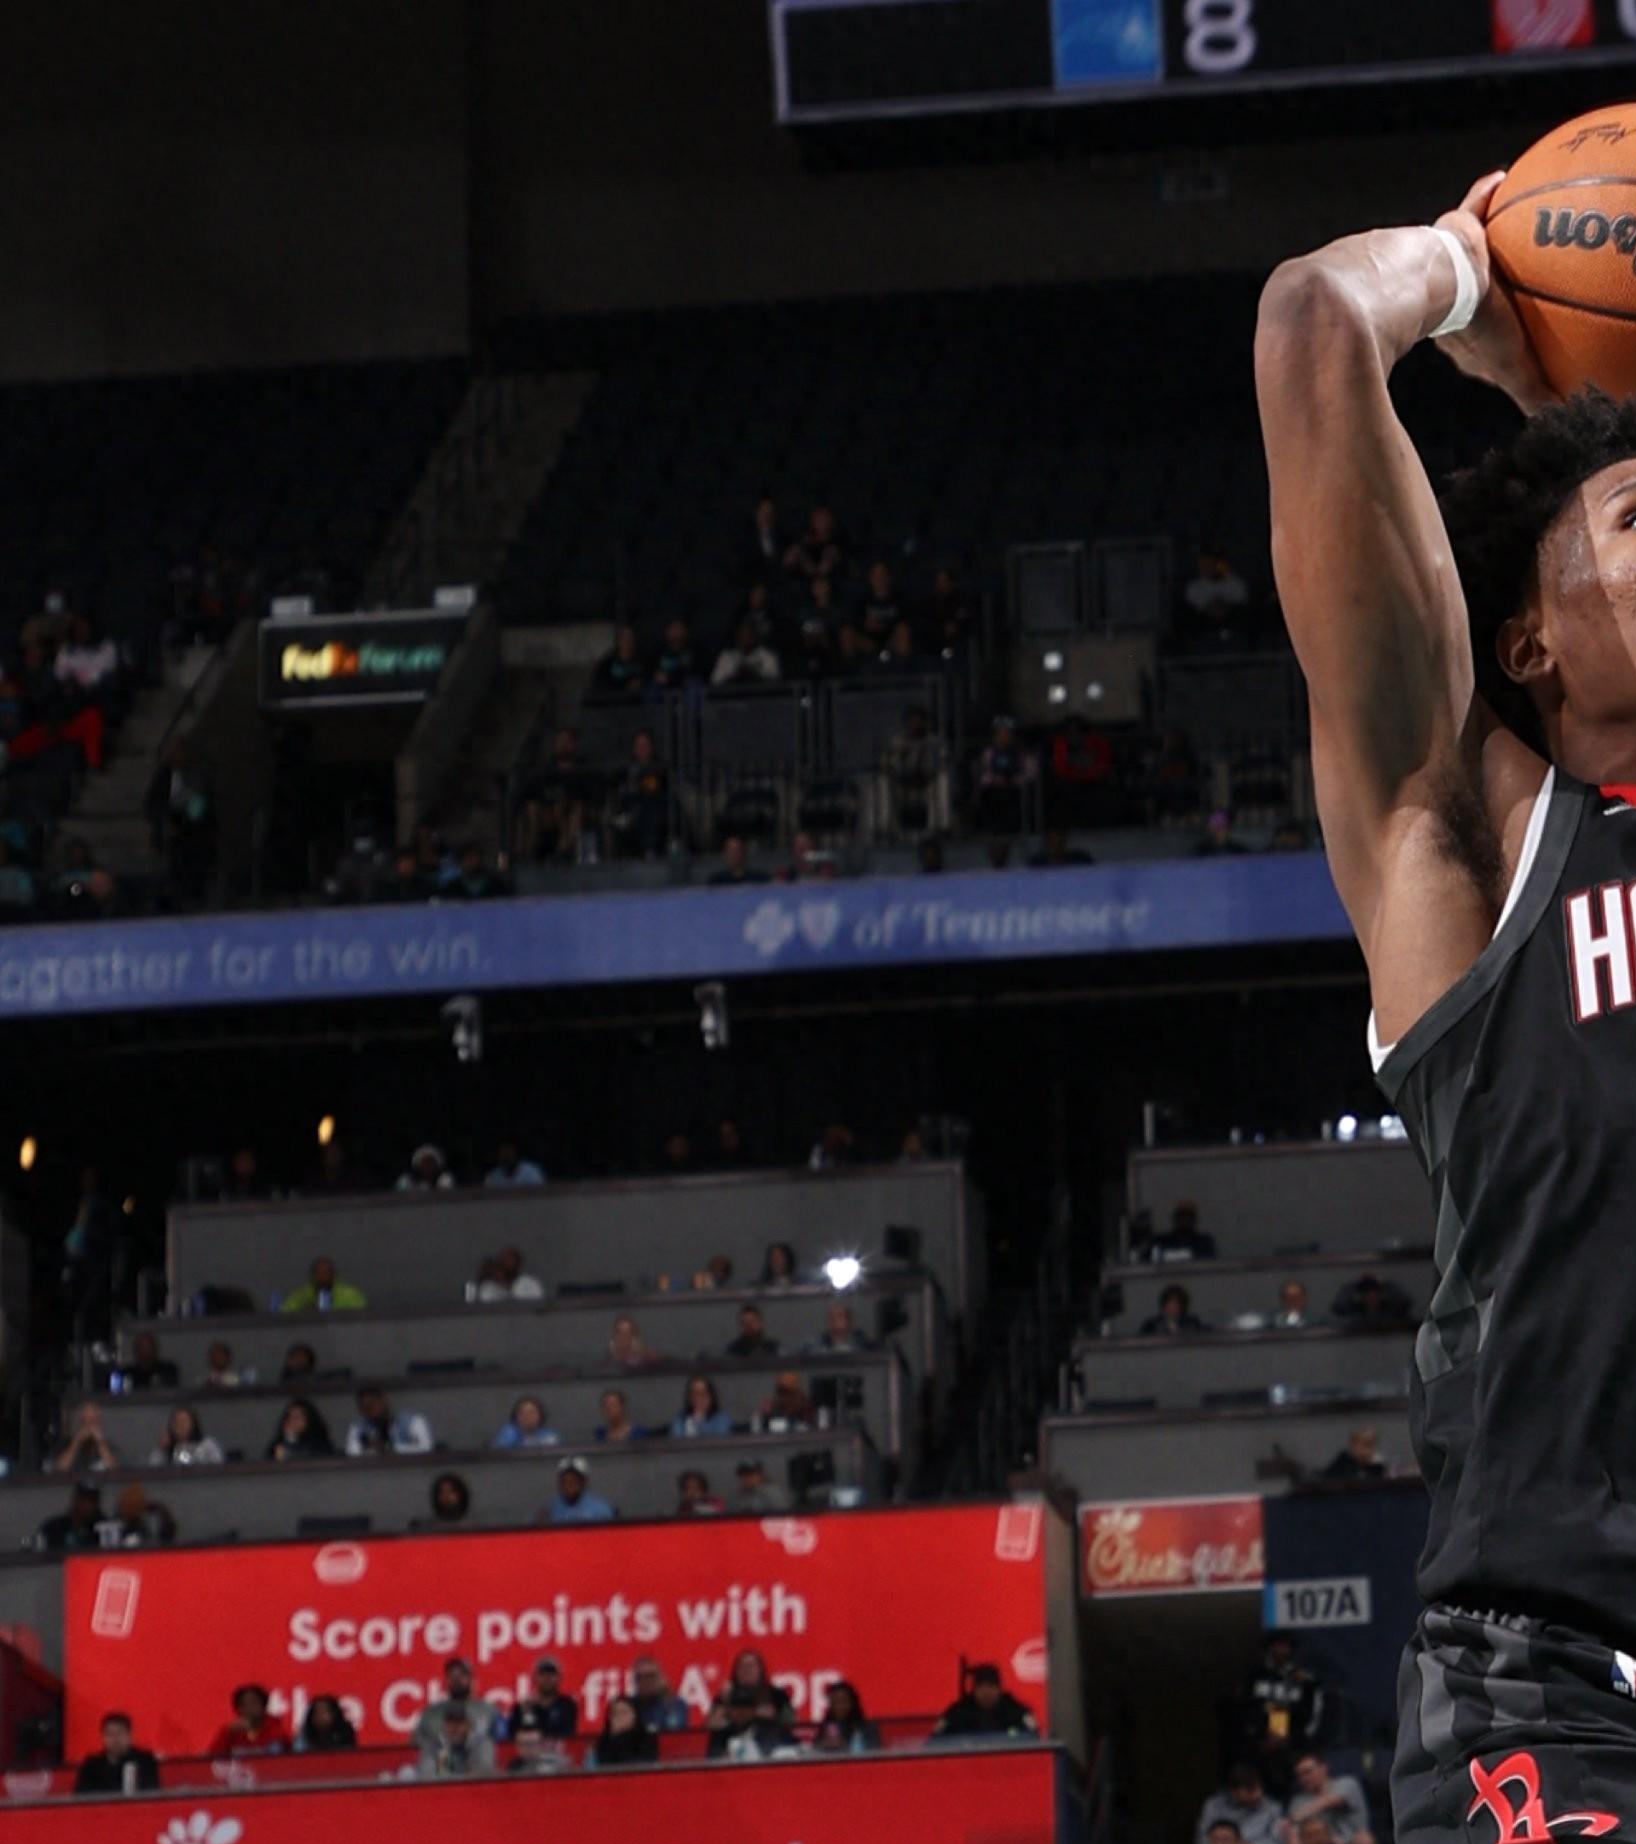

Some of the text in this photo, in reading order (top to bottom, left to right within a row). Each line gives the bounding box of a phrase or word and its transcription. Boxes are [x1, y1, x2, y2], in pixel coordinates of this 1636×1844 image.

[209, 935, 277, 986] for
[293, 930, 374, 982] the
[288, 1583, 807, 1662] Score points with
[1284, 1585, 1360, 1621] 107A
